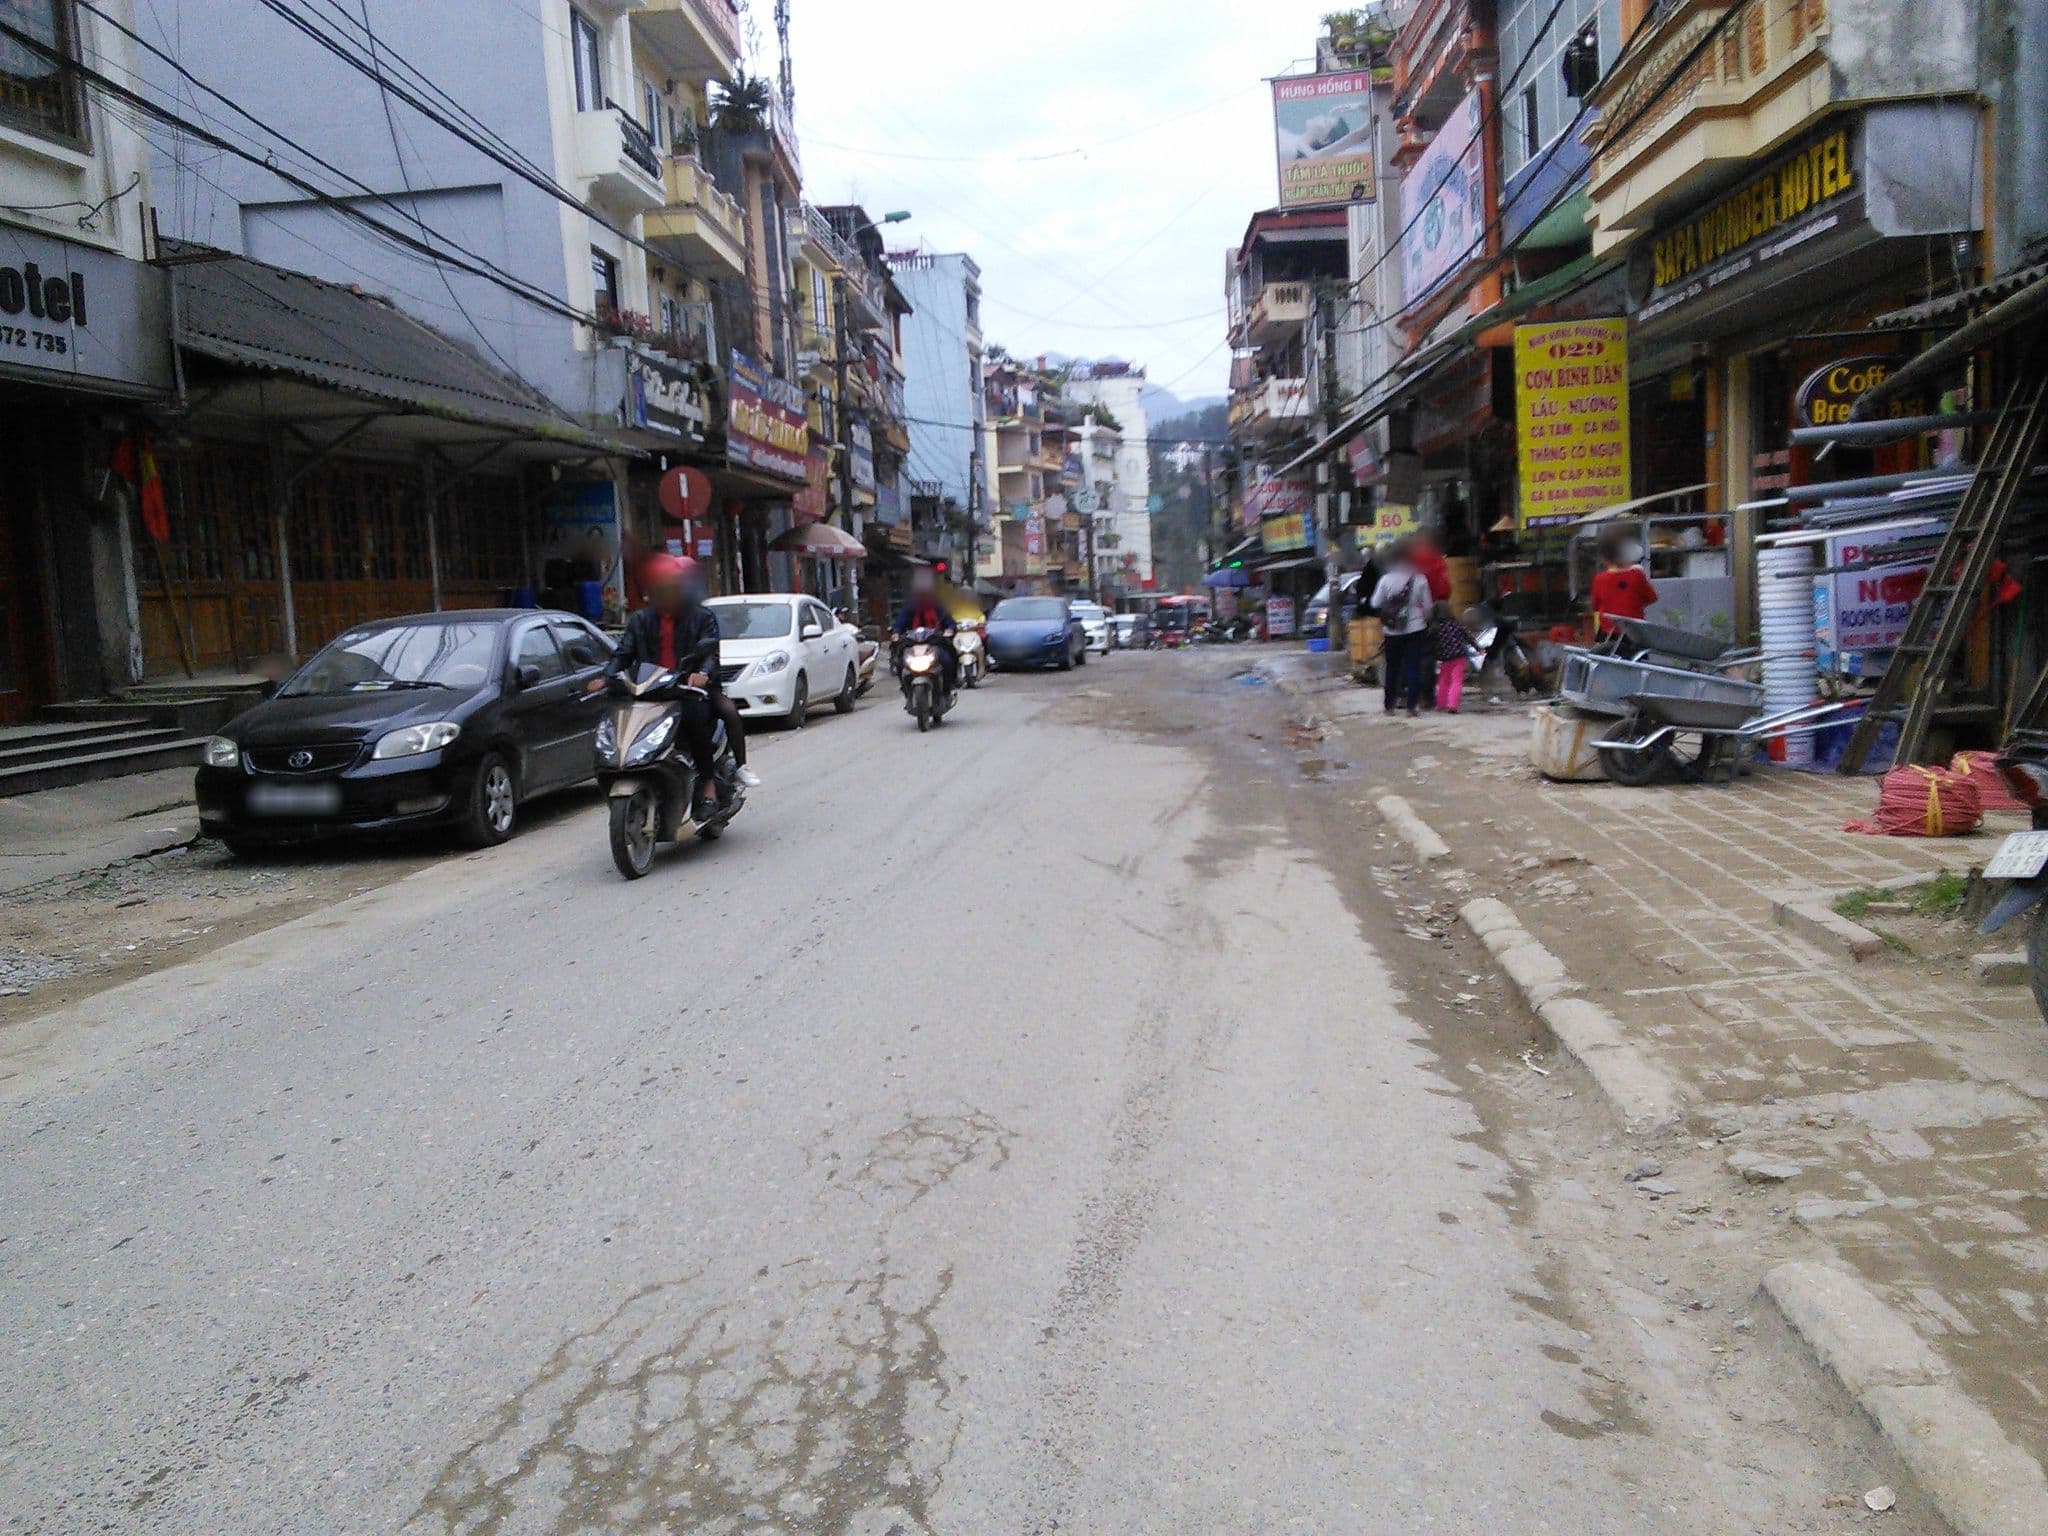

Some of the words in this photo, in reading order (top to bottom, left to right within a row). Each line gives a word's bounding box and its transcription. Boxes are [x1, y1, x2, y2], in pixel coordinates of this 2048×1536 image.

[1654, 223, 1697, 287] SAPA
[1699, 176, 1776, 264] WONDER
[1780, 131, 1852, 221] HOTEL
[31, 331, 67, 354] 735
[1828, 364, 1894, 394] Coff
